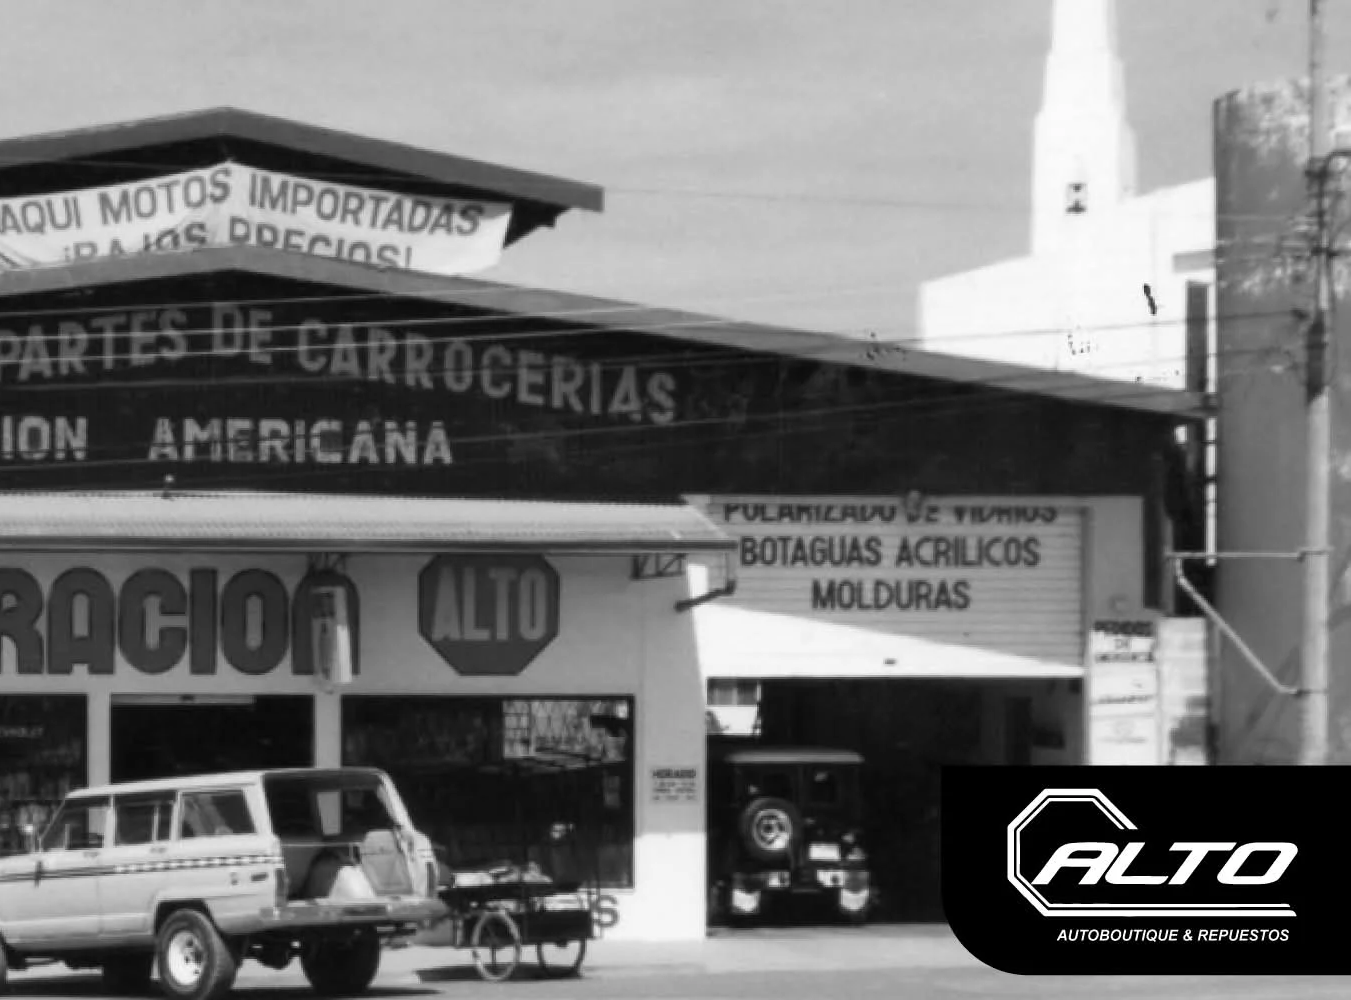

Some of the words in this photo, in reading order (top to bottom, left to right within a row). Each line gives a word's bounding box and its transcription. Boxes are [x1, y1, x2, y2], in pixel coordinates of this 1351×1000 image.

[0, 196, 81, 234] AQUI
[99, 167, 232, 225] MOTOS
[250, 173, 484, 236] IMPORTADAS
[211, 299, 274, 365] DE
[297, 317, 677, 425] CARROCERIAS
[149, 416, 454, 464] AMERICANA
[740, 535, 882, 568] BOTAGUAS
[896, 535, 1041, 568] ACRILICOS
[430, 564, 546, 643] ALTO
[811, 578, 972, 611] MOLDURAS
